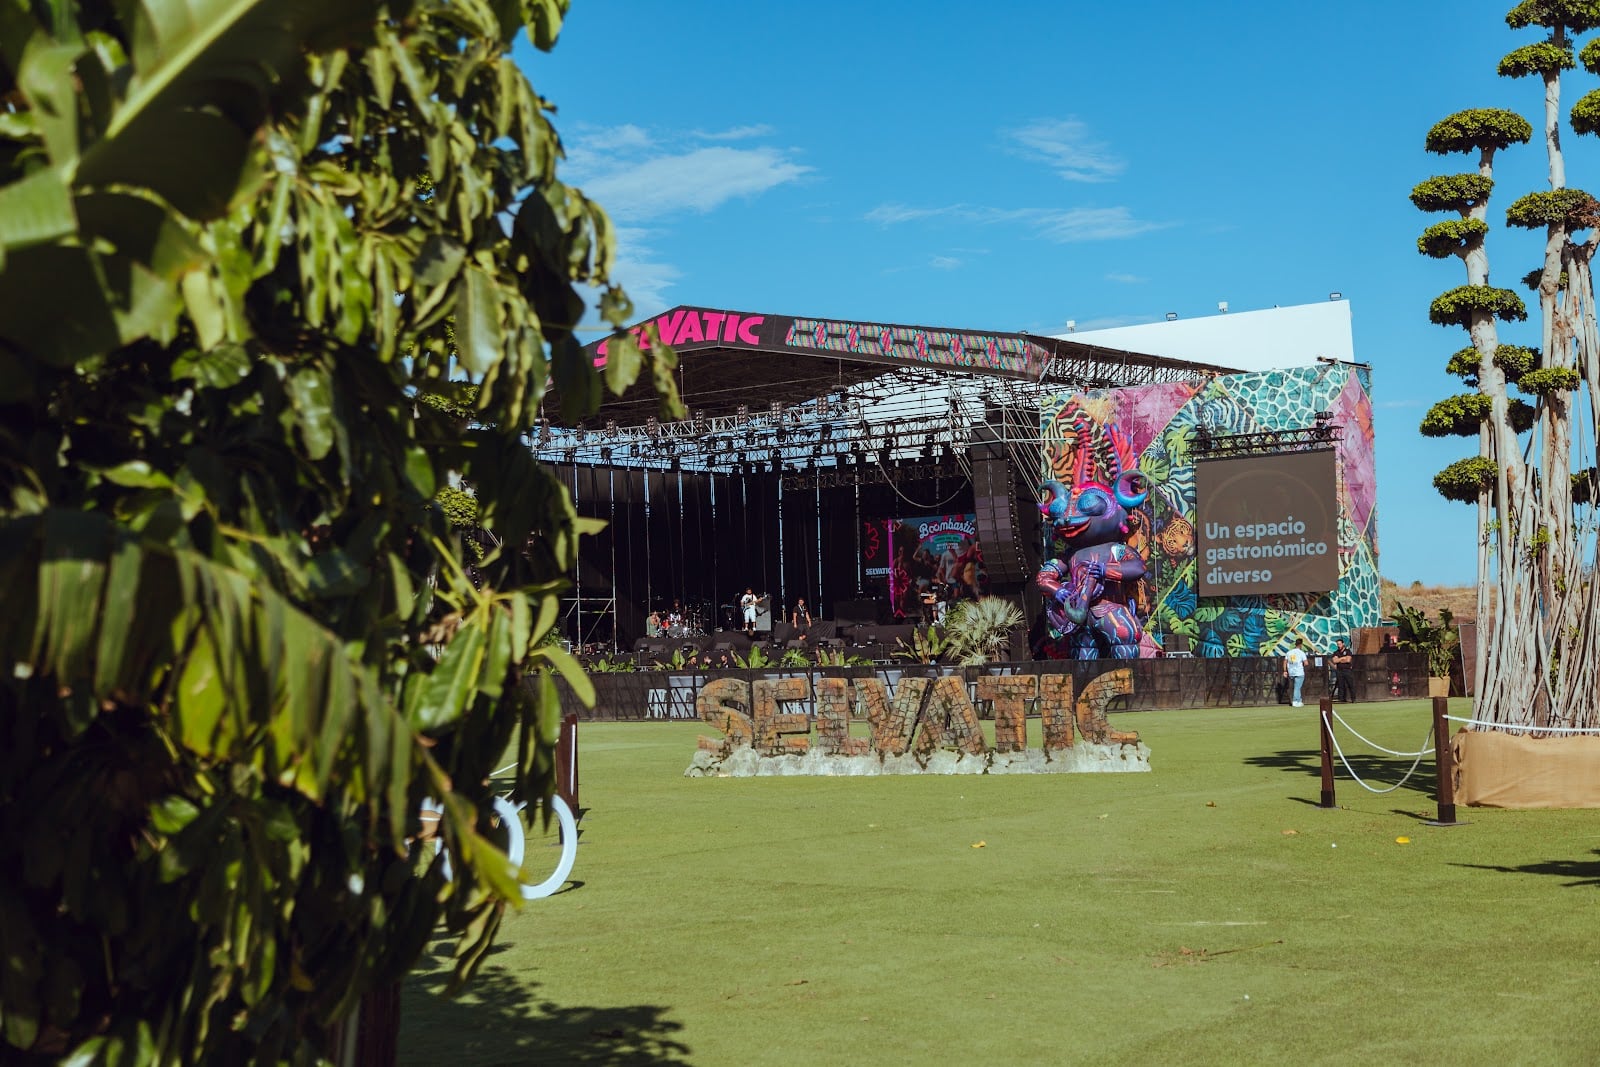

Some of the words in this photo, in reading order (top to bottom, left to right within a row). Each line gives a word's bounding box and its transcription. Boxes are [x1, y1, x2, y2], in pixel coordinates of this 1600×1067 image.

[593, 310, 765, 367] SLVATIC
[919, 518, 976, 539] Boombastic
[1205, 522, 1230, 539] Un
[1235, 516, 1306, 540] espacio
[1206, 538, 1328, 564] gastronómico
[1206, 567, 1272, 584] diverso
[696, 668, 1139, 757] SELVATIC
